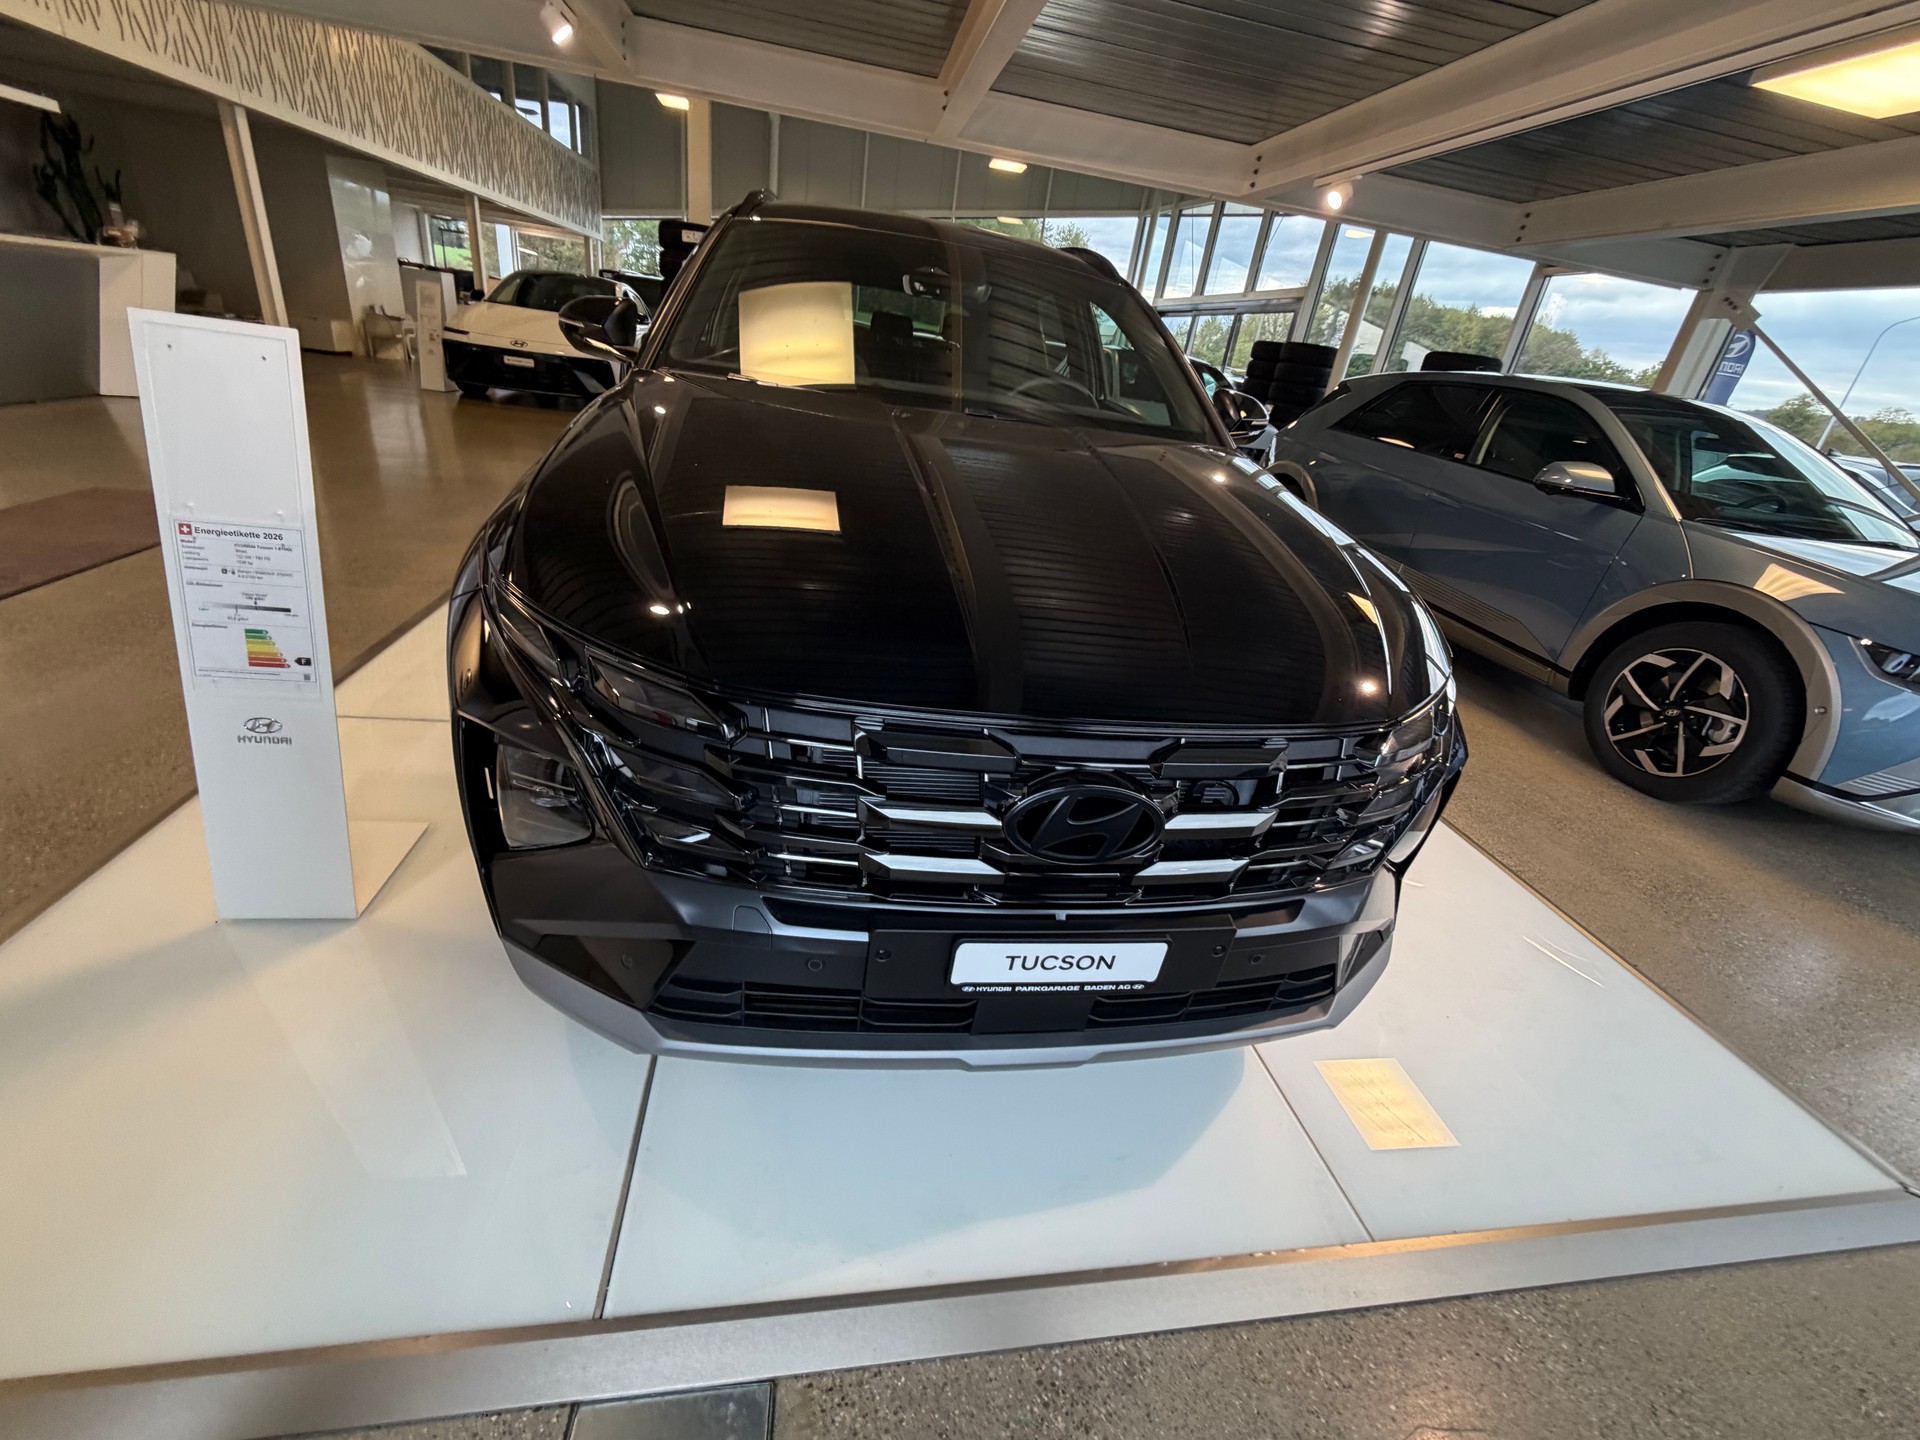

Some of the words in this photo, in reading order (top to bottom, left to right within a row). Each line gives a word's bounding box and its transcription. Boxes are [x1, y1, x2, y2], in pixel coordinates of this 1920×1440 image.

[194, 526, 261, 539] Energieetikette
[263, 532, 284, 541] 2026
[237, 735, 292, 745] HYUNDAI
[1005, 955, 1117, 971] TUCSON
